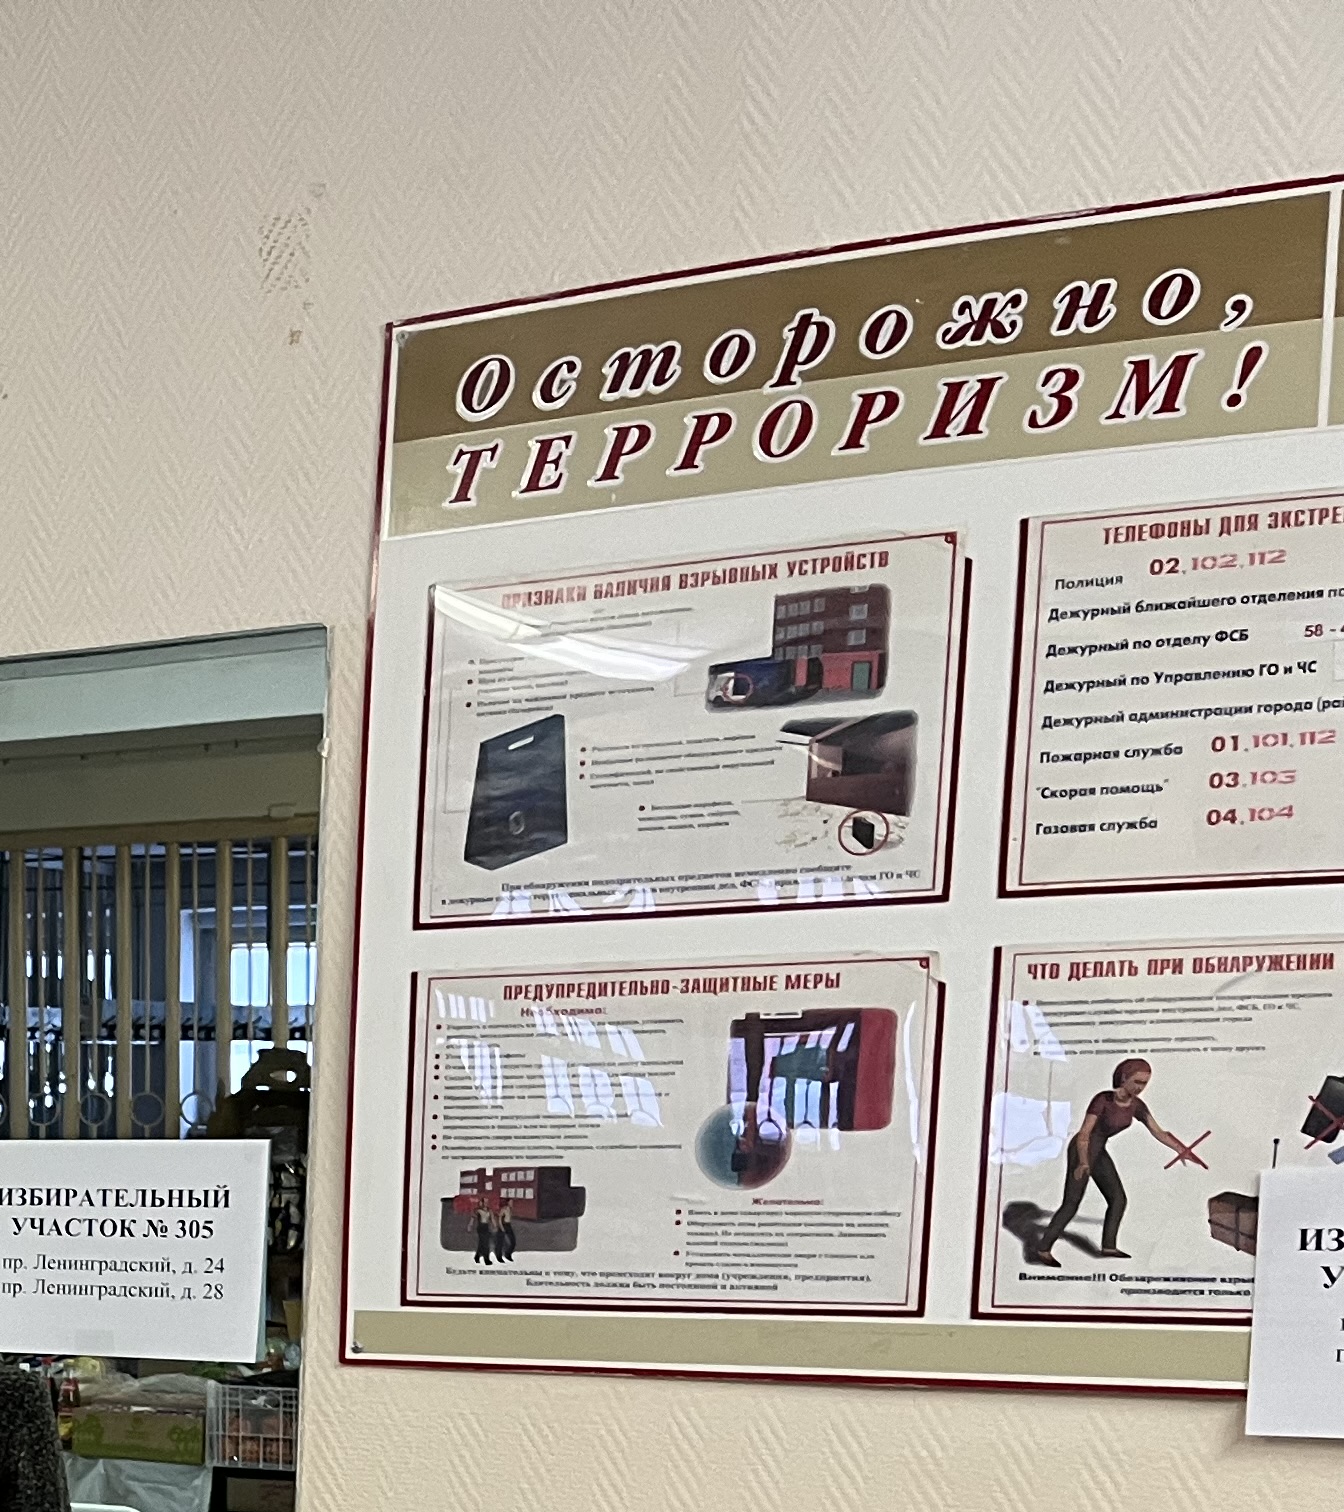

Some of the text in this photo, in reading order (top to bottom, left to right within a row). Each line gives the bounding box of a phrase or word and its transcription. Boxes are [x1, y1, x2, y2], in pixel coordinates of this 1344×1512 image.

[457, 266, 1254, 422] Осторожно,
[444, 342, 1268, 508] ТЕРРОРИЗМ!
[1103, 505, 1344, 545] ТЕЛЕФОНЫ ДЛЯ ЭКСТРЕ
[678, 562, 778, 590] ВЗРЫВНЫХ
[787, 550, 890, 579] УСТРОЙСТВ
[1055, 575, 1124, 591] Полиция
[1048, 602, 1131, 623] Дежурный
[1135, 595, 1237, 614] ближайшего
[1240, 588, 1324, 605] отделения
[1046, 638, 1129, 659] Дежурный
[1132, 638, 1152, 651] по
[1155, 632, 1212, 649] отделу
[1215, 628, 1249, 642] ФСБ
[1043, 661, 1317, 694] Дежурный по Управлению ГО и ЧС
[1041, 710, 1125, 730] Дежурный
[1128, 703, 1253, 724] администрации
[1257, 700, 1313, 716] города
[1039, 747, 1120, 765] Пожарная
[1124, 743, 1183, 761] служба
[1035, 819, 1095, 836] Газовая
[1099, 816, 1158, 833] служба
[784, 972, 841, 990] МЕРЫ
[1027, 952, 1334, 981] ЧТО ДЕЛАТЬ ПРИ ОБНАРУЖЕНИИ
[11, 1217, 215, 1239] УЧАСТОК № 305
[2, 1254, 225, 1275] пр. Ленинградский, д. 24
[2, 1279, 224, 1301] пр. Ленинградский, д. 28
